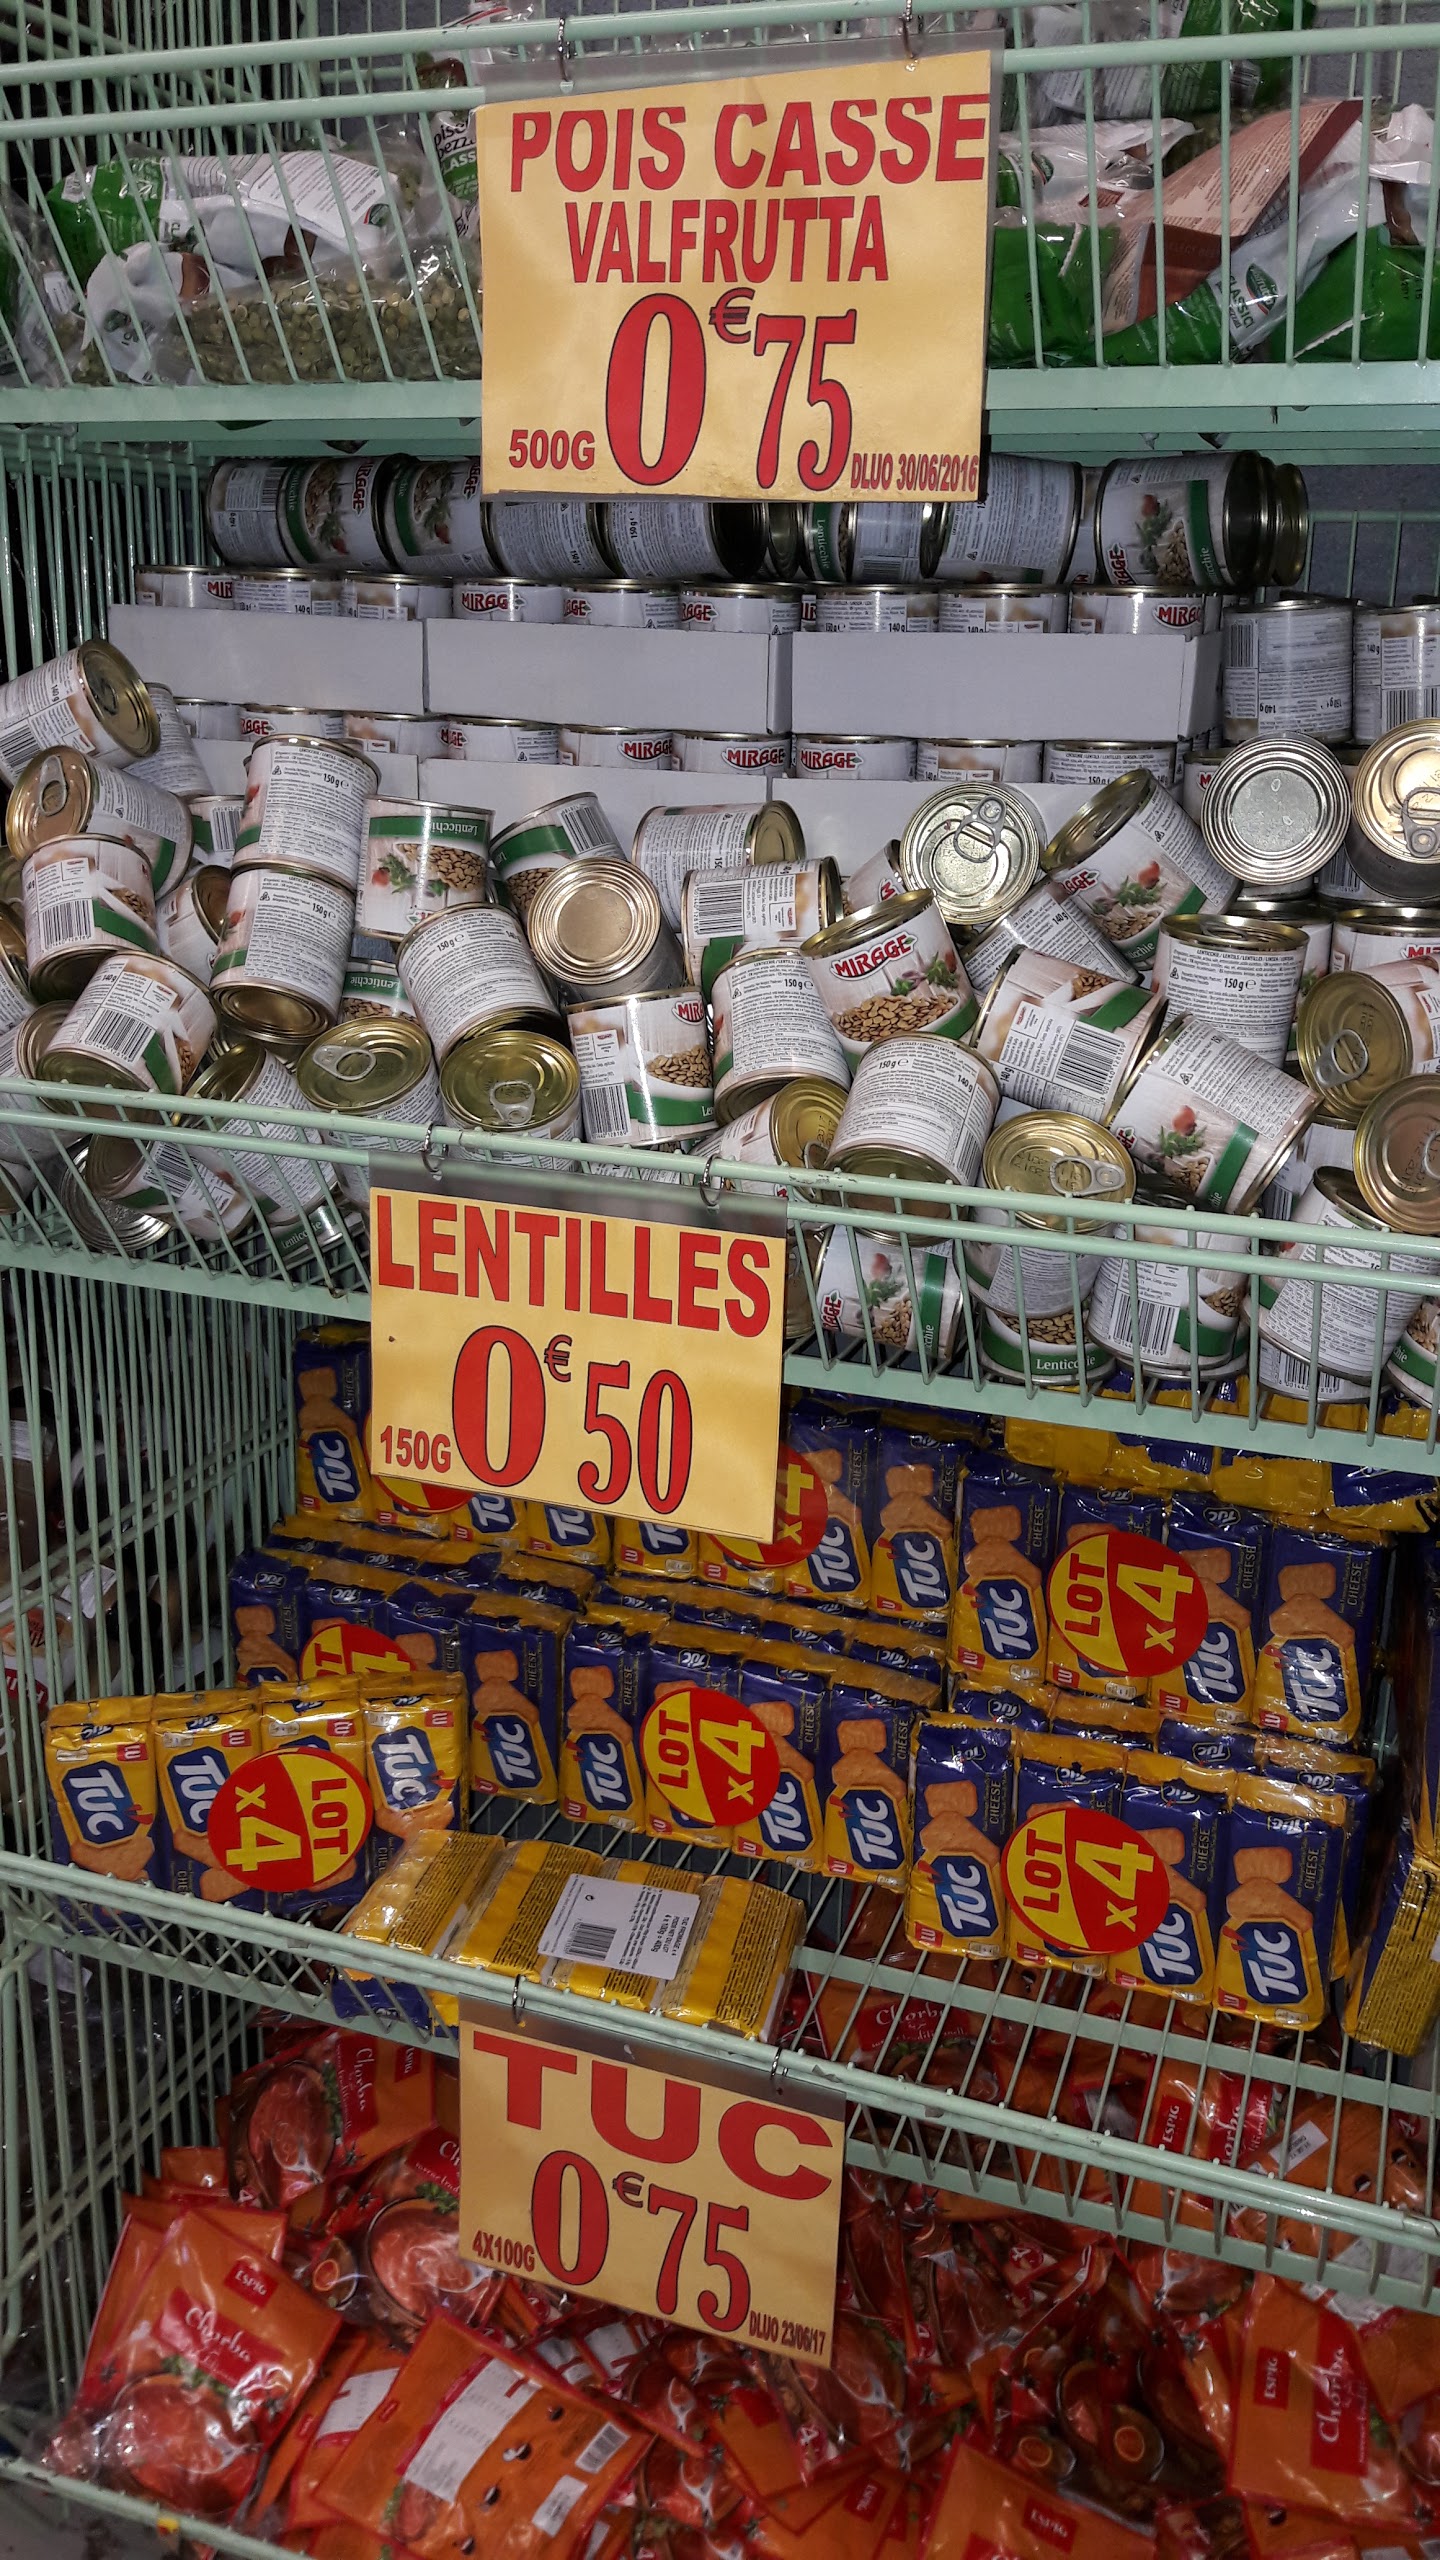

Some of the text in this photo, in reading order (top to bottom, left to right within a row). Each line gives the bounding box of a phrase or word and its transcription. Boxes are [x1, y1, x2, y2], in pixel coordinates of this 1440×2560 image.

[511, 94, 990, 192] POIS CASSE
[565, 196, 889, 283] VALFRUTTA
[508, 429, 596, 471] 500G
[851, 453, 979, 492] DLUO 30/06/2016
[726, 748, 785, 768] MIRAGE
[834, 934, 912, 977] MIRAGE
[377, 1195, 770, 1338] LENTILLES
[1036, 1355, 1096, 1372] Lenticcie
[380, 1425, 452, 1473] 150G
[1033, 1503, 1044, 1548] CHEESE
[1066, 1553, 1105, 1637] LOT
[1348, 1561, 1363, 1606] CHEESE
[1116, 1563, 1194, 1654] x4
[658, 1709, 690, 1789] LOT
[700, 1719, 766, 1806] x4
[312, 1778, 348, 1855] LOT
[988, 1779, 1001, 1824] CHEESE
[226, 1783, 301, 1872] x4
[1198, 1827, 1210, 1873] CHEESE
[1023, 1827, 1062, 1913] LOT
[1075, 1840, 1155, 1933] x4
[1304, 1846, 1318, 1890] CHEESE
[474, 2030, 833, 2200] TUC
[1162, 2105, 1180, 2143] ESPIG
[472, 2230, 535, 2272] 4X100G
[749, 2310, 826, 2356] DLUO 23/06/17
